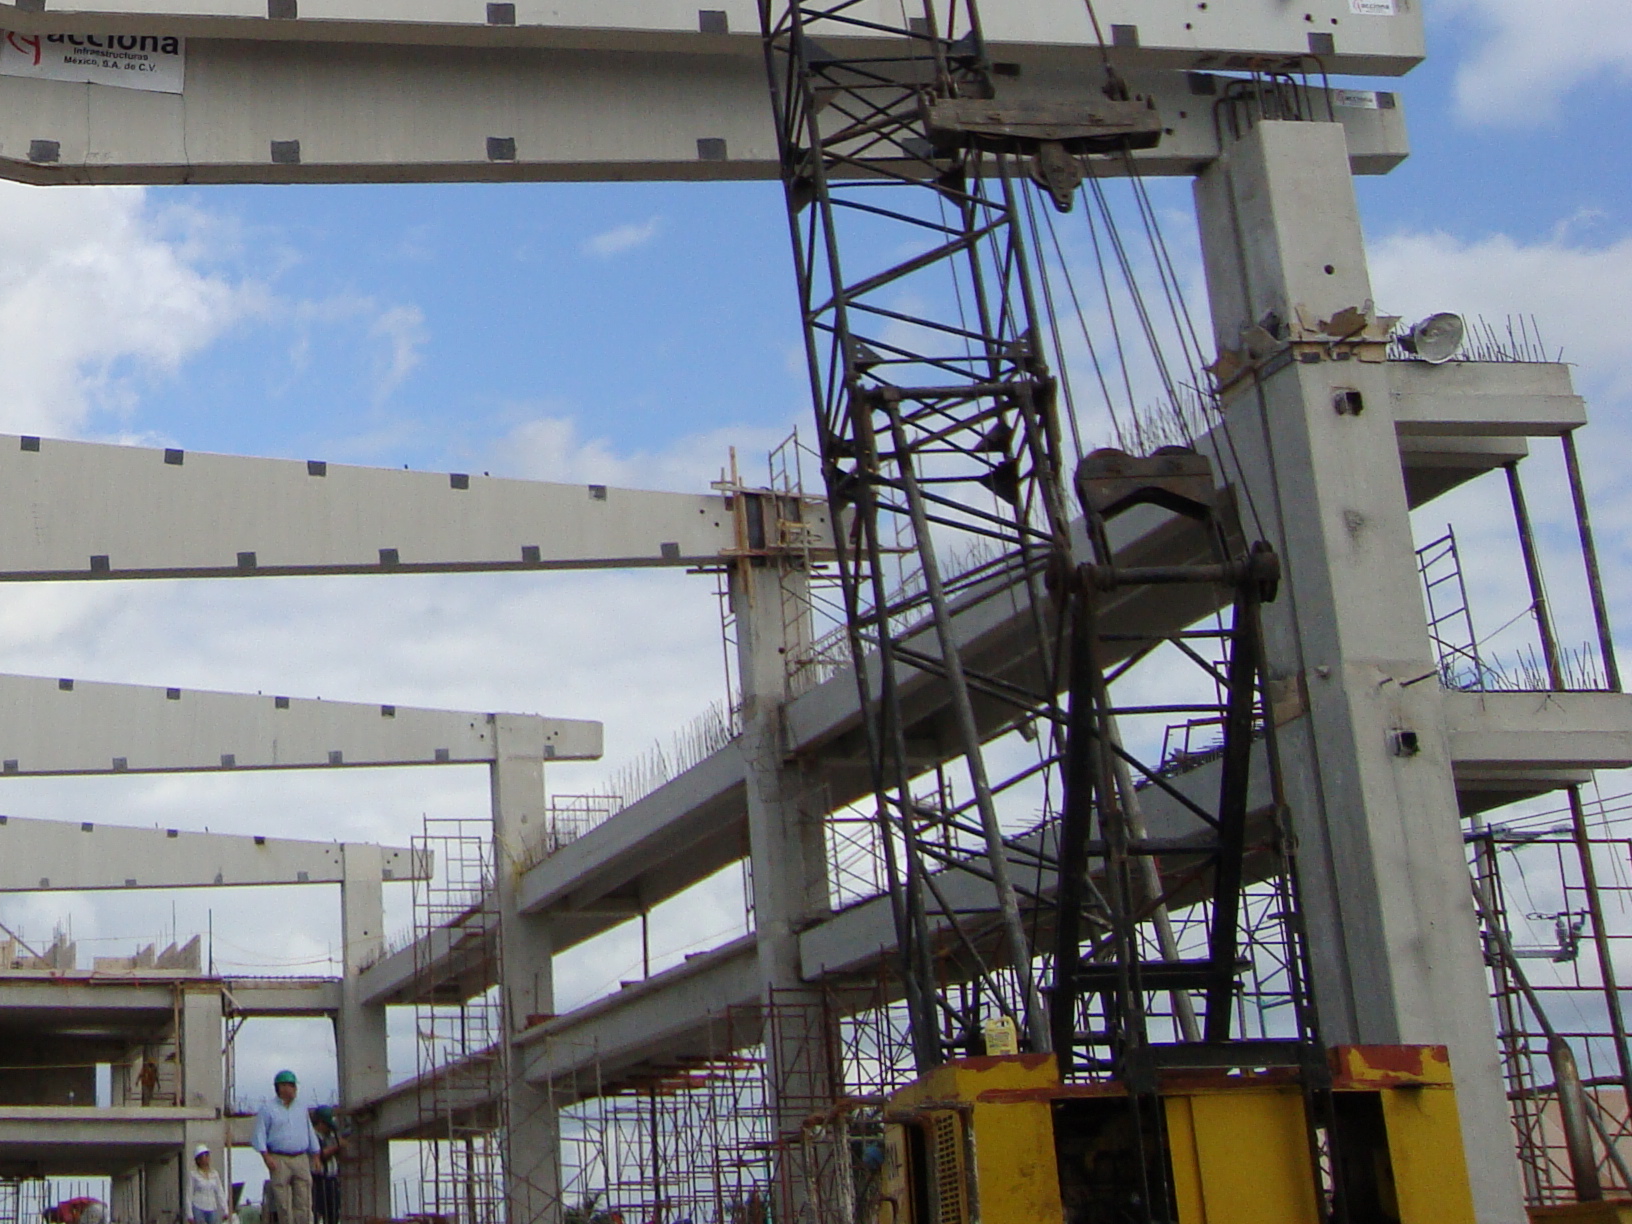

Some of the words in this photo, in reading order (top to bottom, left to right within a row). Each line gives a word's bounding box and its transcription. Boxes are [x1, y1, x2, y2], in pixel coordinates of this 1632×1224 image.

[73, 47, 149, 61] Infraestructuras
[124, 62, 136, 71] de
[138, 62, 157, 73] C.V.
